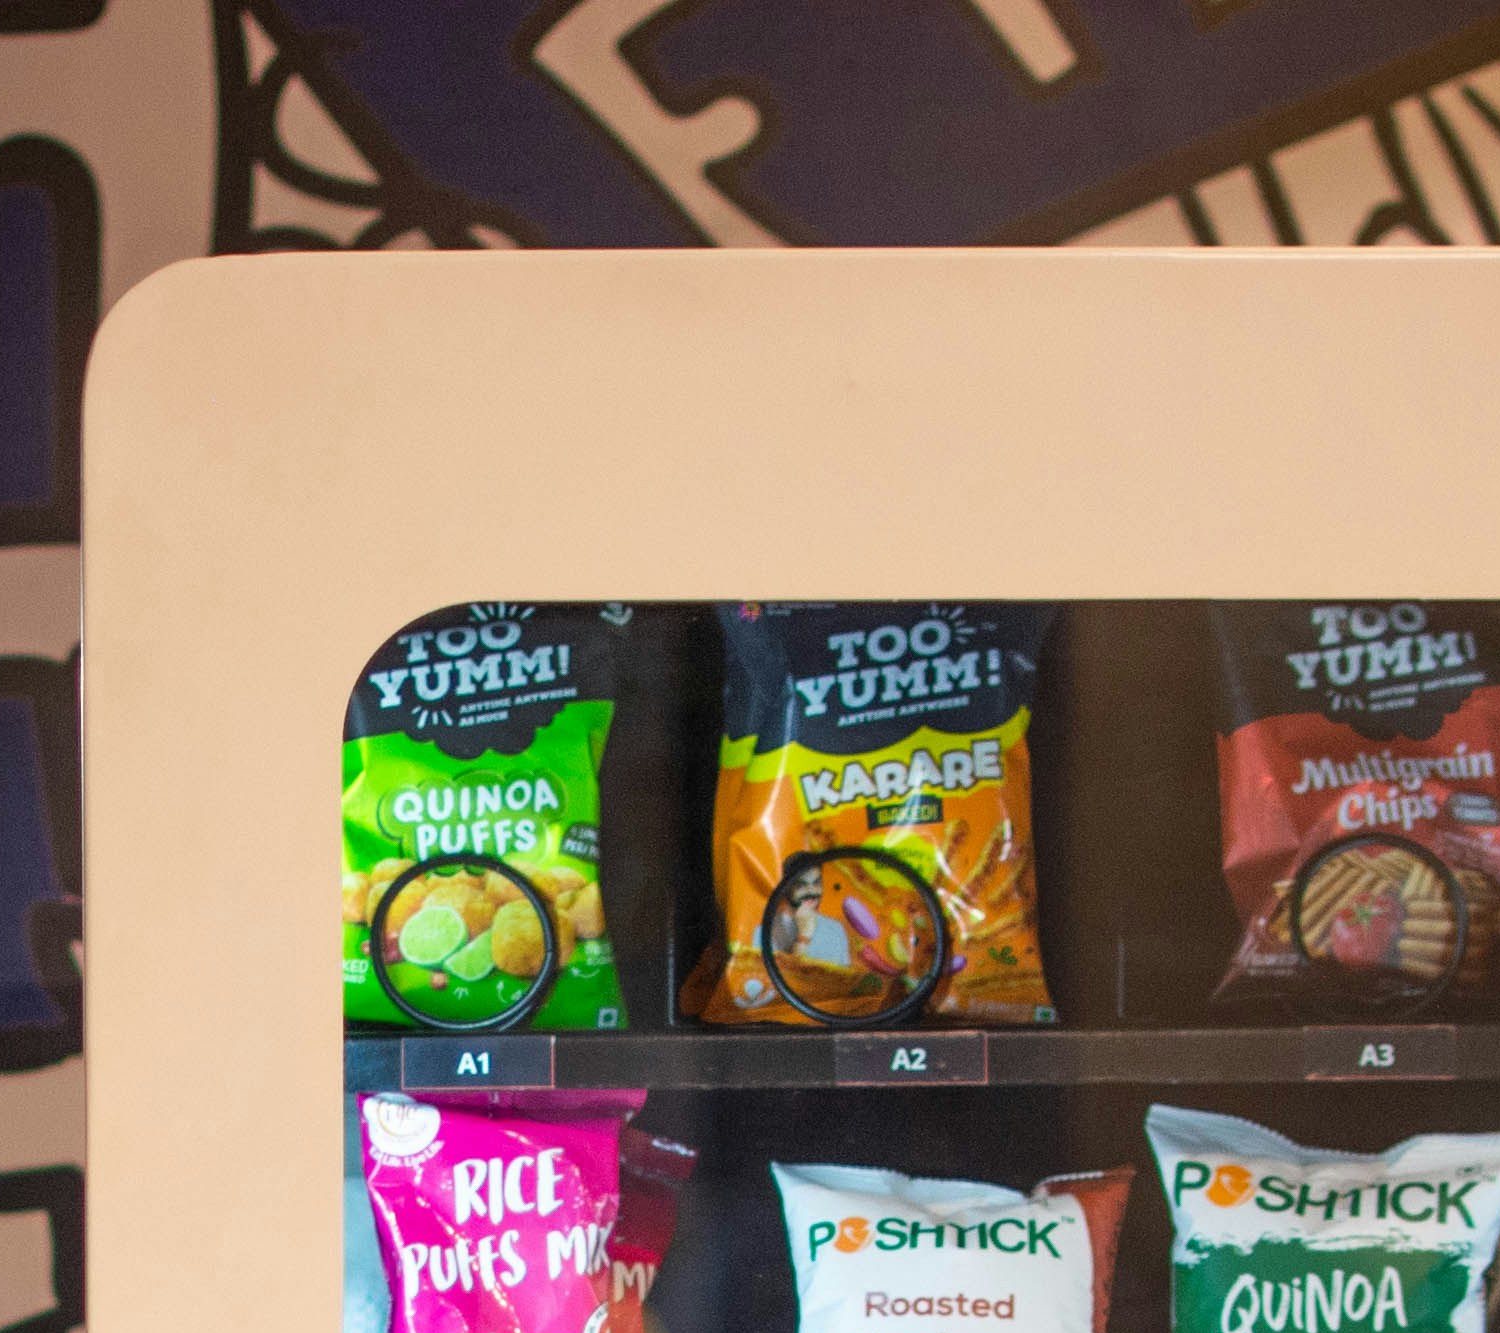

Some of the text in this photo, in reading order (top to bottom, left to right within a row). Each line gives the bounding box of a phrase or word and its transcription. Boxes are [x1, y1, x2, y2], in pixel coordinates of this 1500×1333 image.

[397, 620, 522, 663] TOO
[828, 619, 950, 669] TOO
[1311, 603, 1426, 646] TOO
[368, 644, 571, 709] YUMM!
[795, 649, 1000, 717] YUMM!
[1286, 631, 1478, 689] YUMM!
[800, 738, 1001, 812] KARARE
[1291, 743, 1494, 795] Multigrain
[392, 777, 559, 823] QUINOA
[1336, 786, 1438, 832] Chips
[416, 818, 537, 862] PUFFS
[456, 1052, 490, 1075] A1
[890, 1048, 927, 1071] A2
[1358, 1043, 1396, 1068] A3
[452, 1147, 565, 1226] RICE
[400, 1220, 614, 1300] PUFFS MIX
[865, 1291, 1016, 1320] Roasted
